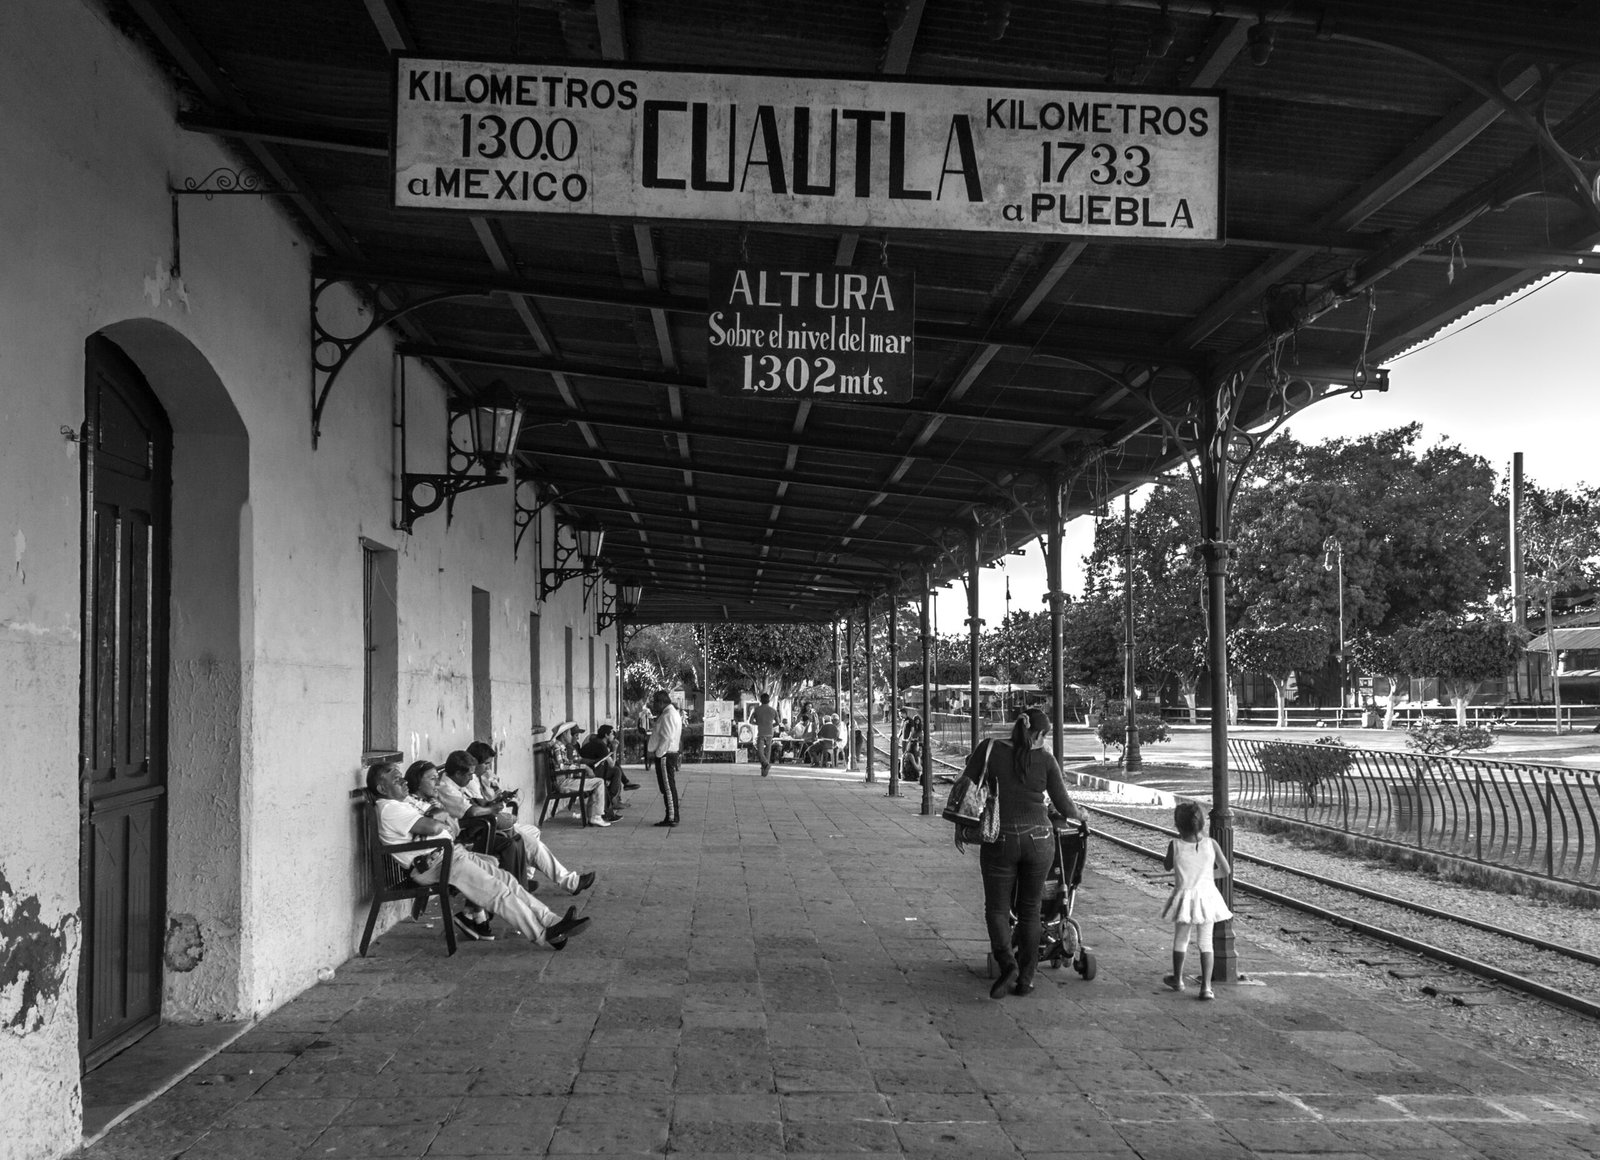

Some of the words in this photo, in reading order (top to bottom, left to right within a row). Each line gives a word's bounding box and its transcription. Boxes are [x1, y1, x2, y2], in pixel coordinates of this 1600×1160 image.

[409, 69, 638, 111] KILOMETROS
[459, 114, 579, 162] 130.0
[987, 98, 1209, 138] KILOMETROS
[642, 100, 984, 203] CUAUTLA
[1041, 142, 1151, 187] 173.3
[435, 167, 588, 203] MEXICO
[1002, 204, 1024, 222] a
[1031, 194, 1194, 229] PUEBLA
[729, 269, 895, 312] ALTURA
[708, 311, 765, 348] Sobre
[768, 313, 783, 349] el
[787, 314, 836, 351] nivel
[838, 315, 866, 353] del
[870, 333, 912, 354] mar
[742, 354, 836, 394] 1,302
[840, 364, 888, 396] mts.
